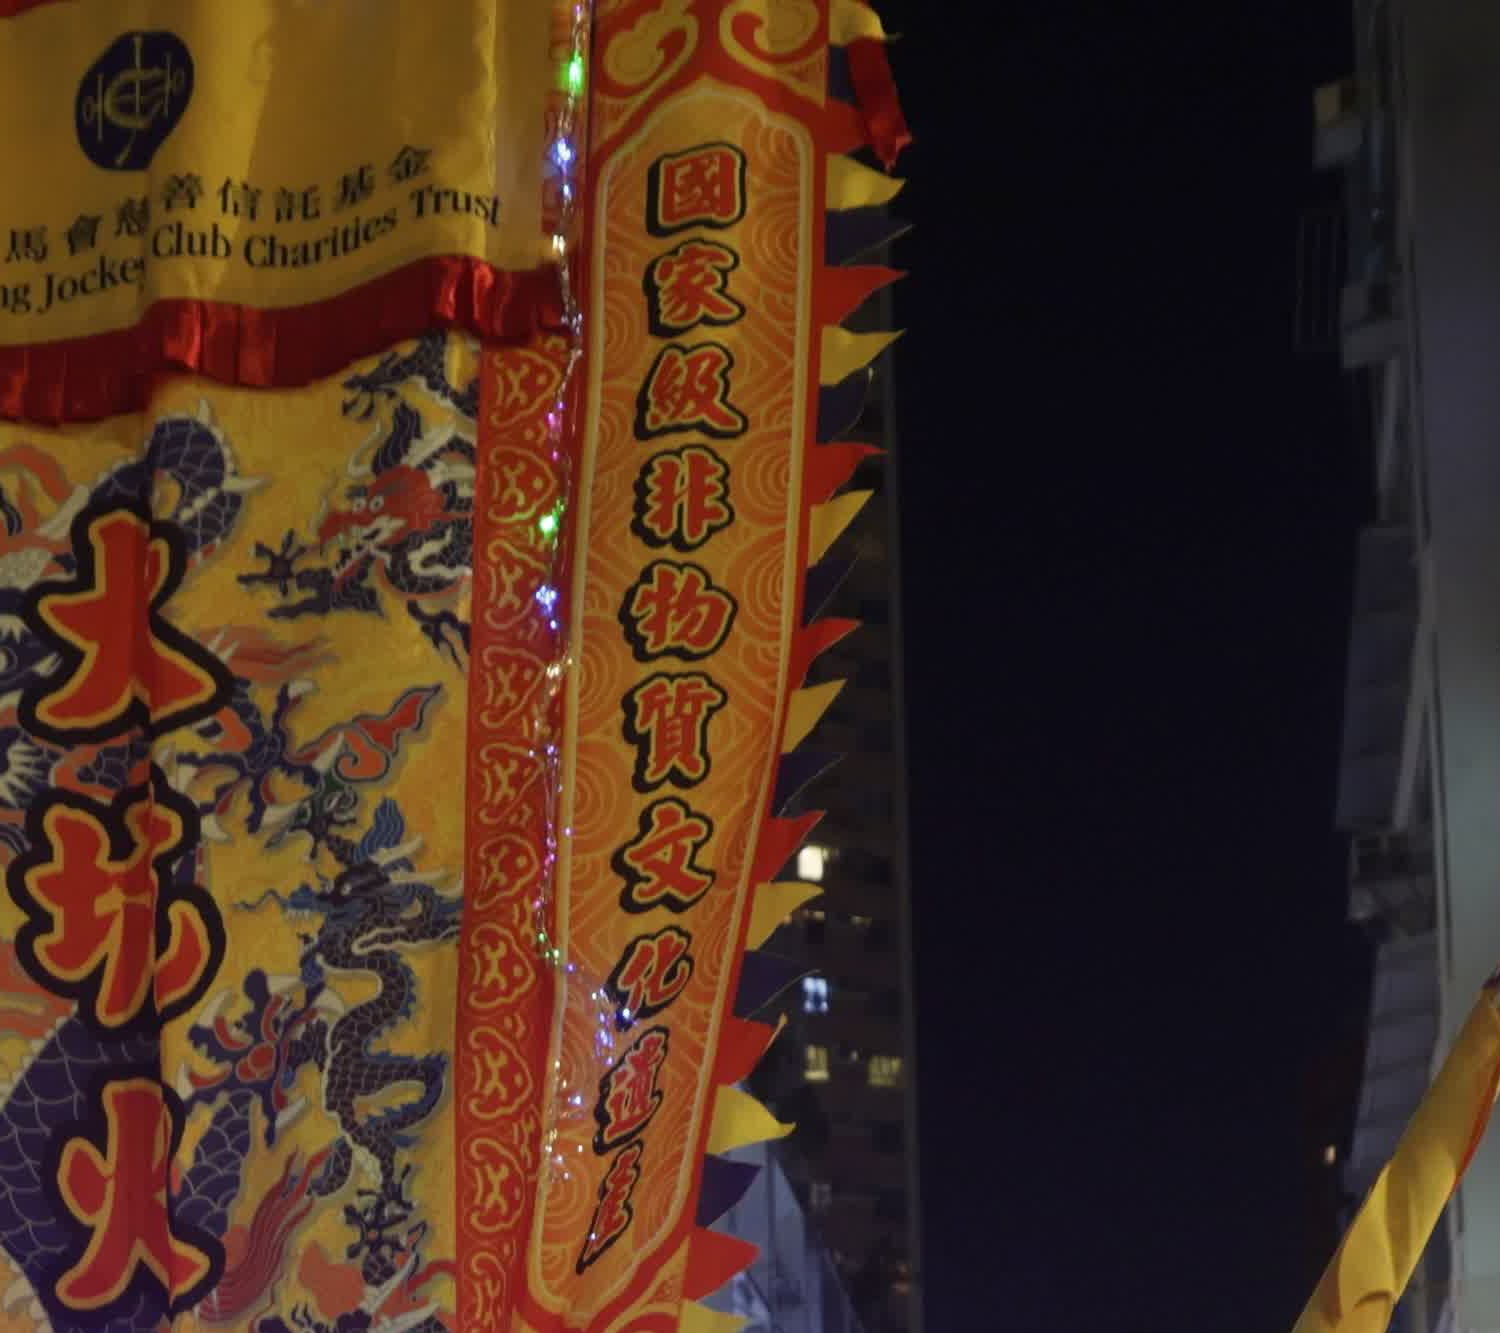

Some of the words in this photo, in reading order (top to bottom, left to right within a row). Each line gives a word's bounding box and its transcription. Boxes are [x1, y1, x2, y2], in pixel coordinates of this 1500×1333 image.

[151, 222, 233, 260] Club
[243, 205, 398, 269] Charities
[409, 185, 501, 229] Trust
[576, 141, 749, 1275] 國家級非物質文化遺產
